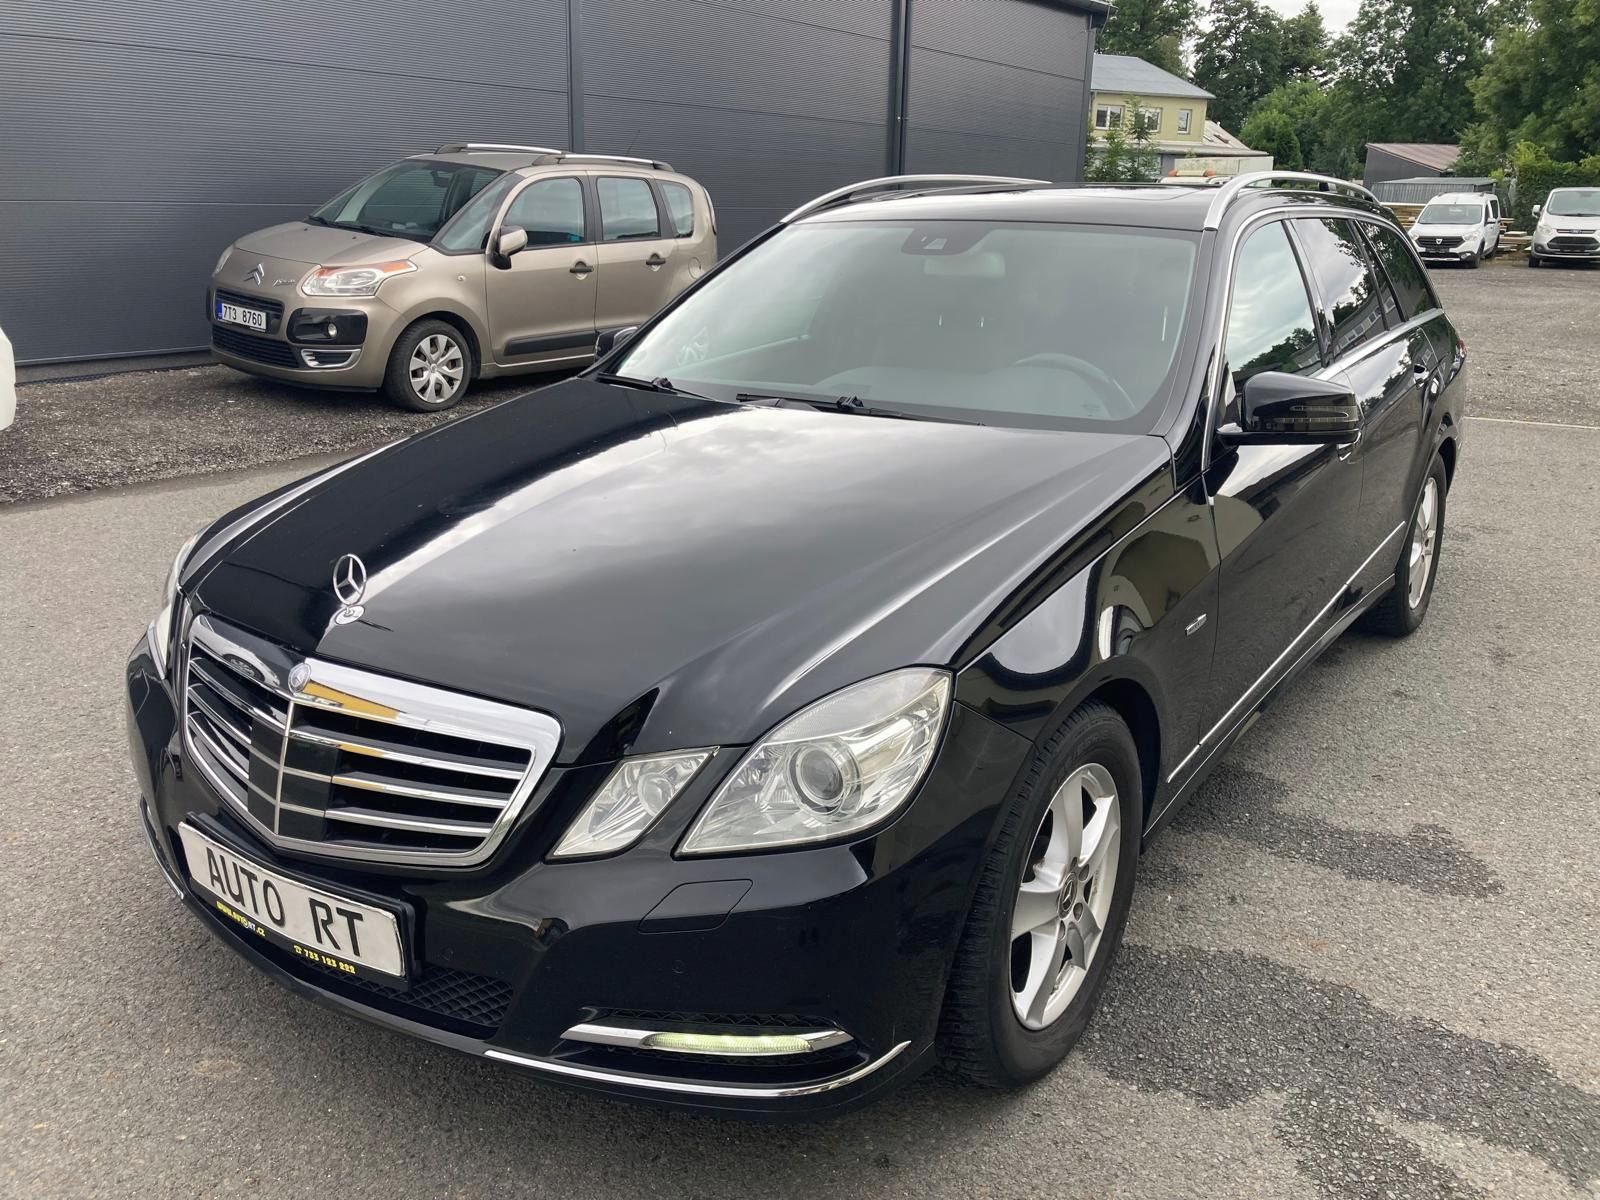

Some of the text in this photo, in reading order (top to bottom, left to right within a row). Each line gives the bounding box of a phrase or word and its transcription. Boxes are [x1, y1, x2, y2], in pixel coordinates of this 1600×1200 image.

[223, 305, 262, 327] 7T3 8760
[206, 847, 364, 957] AUTO RT
